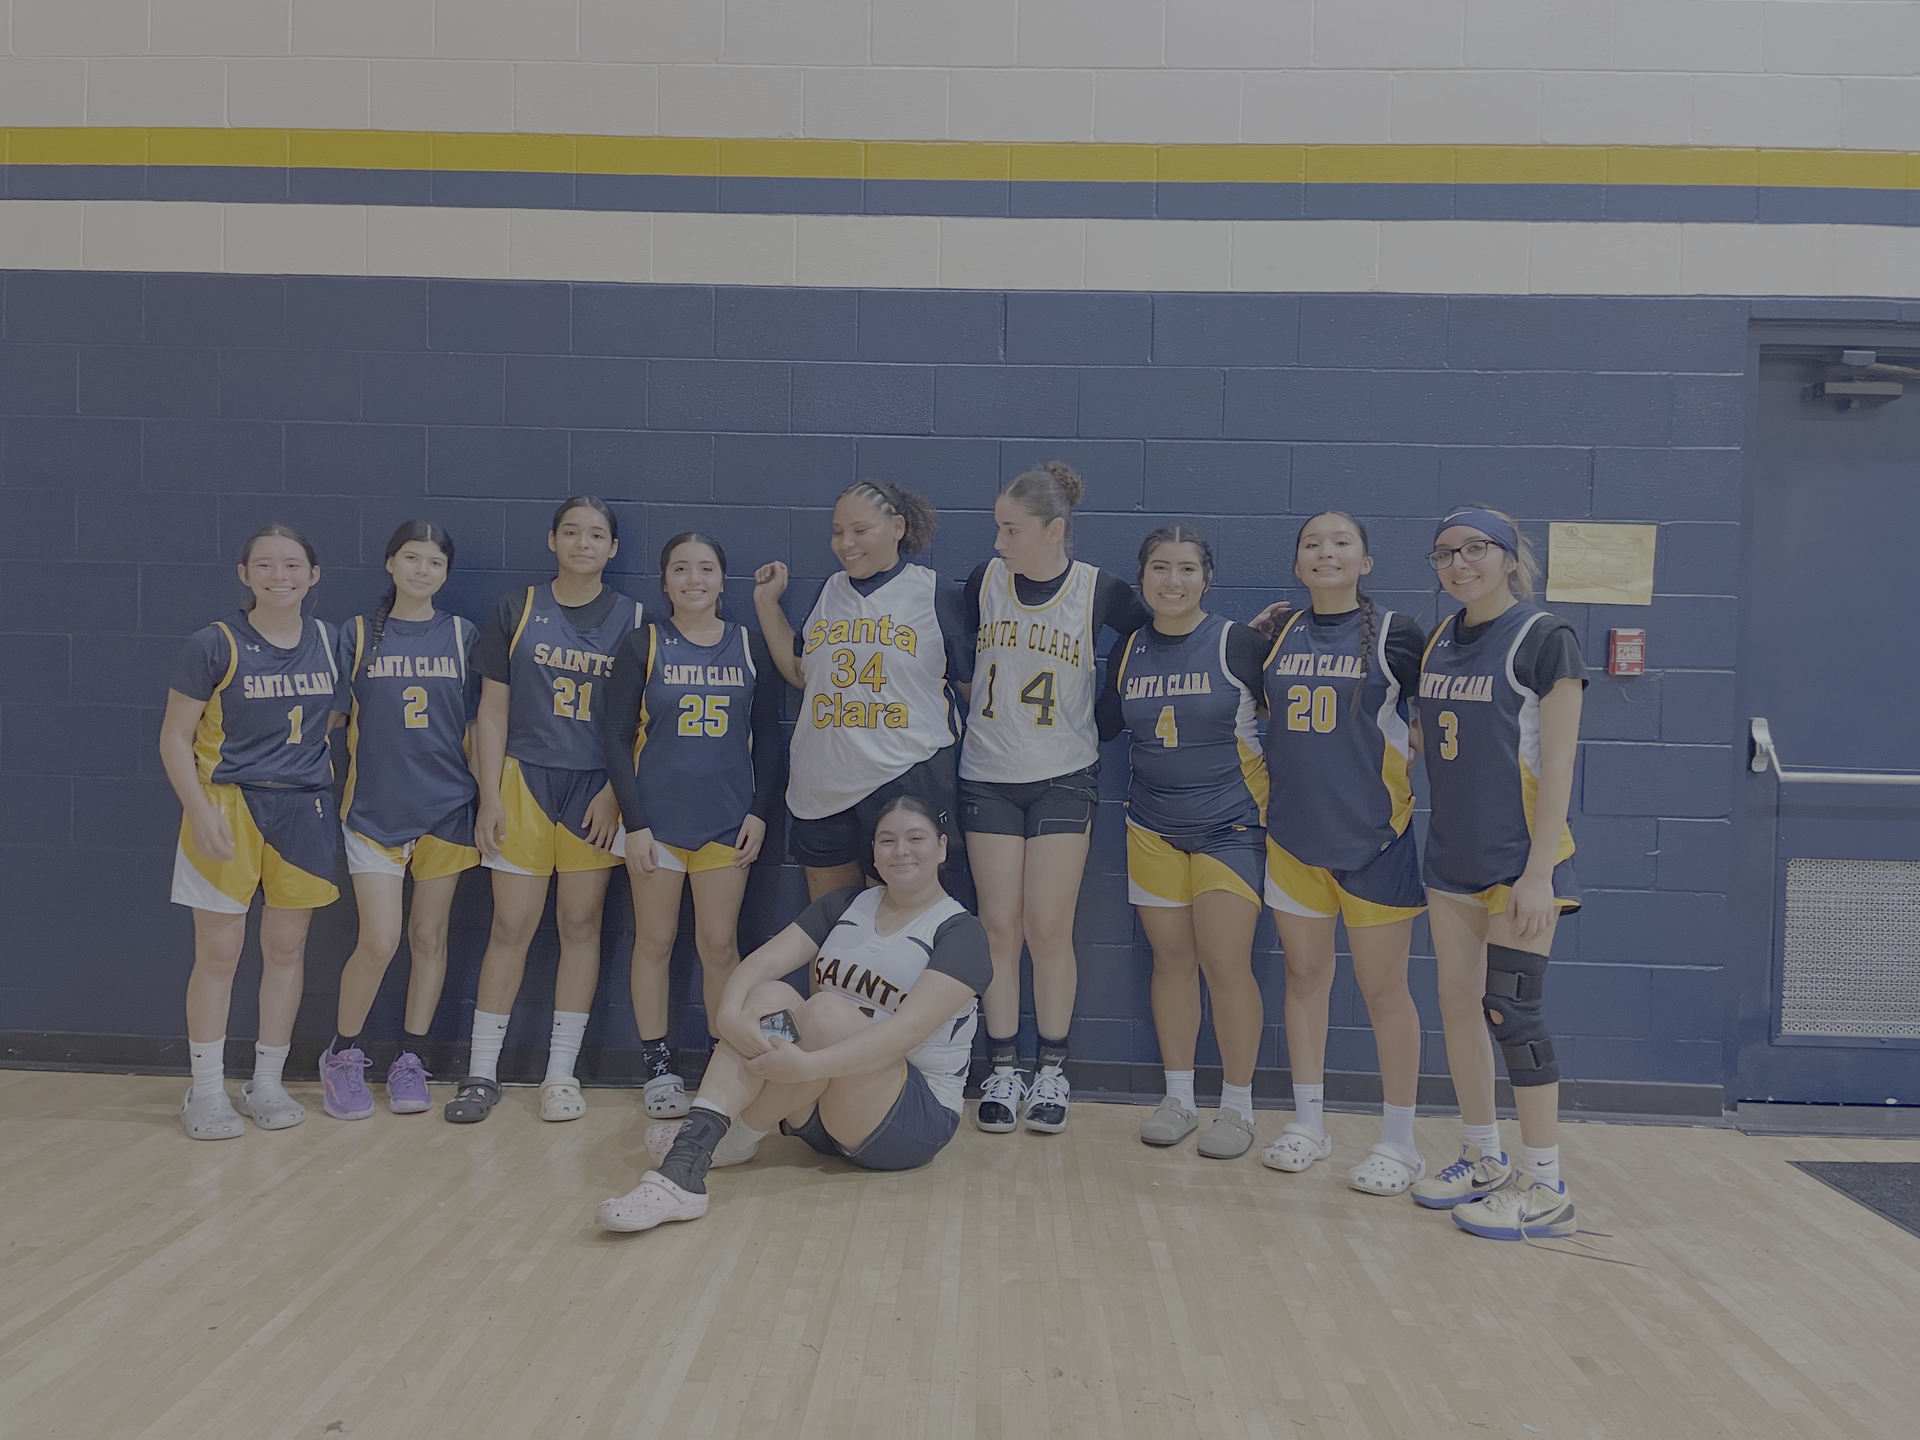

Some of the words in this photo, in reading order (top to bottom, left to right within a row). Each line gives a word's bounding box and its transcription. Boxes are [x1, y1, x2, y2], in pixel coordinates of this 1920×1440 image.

[976, 620, 1019, 654] SANTA
[1028, 623, 1080, 668] CLARA
[1617, 645, 1641, 653] FIRE
[366, 655, 413, 679] SANTA
[415, 656, 458, 679] CLARA
[663, 663, 705, 686] SANTA
[706, 665, 745, 687] CLARA
[830, 648, 887, 692] 34
[1125, 675, 1164, 701] SANTA
[1166, 671, 1212, 697] CLARA
[1276, 653, 1315, 676] SANTA
[1316, 654, 1362, 679] CLARA
[243, 674, 295, 699] SANTA
[552, 676, 593, 722] 21
[1419, 672, 1453, 700] ANTA
[1449, 675, 1494, 703] CLARA
[285, 705, 303, 745] 1
[402, 685, 429, 729] 2
[677, 693, 731, 738] 25
[812, 692, 909, 730] Clara
[1154, 705, 1179, 748] 4
[1287, 684, 1337, 734] 20
[1438, 710, 1459, 761] 3
